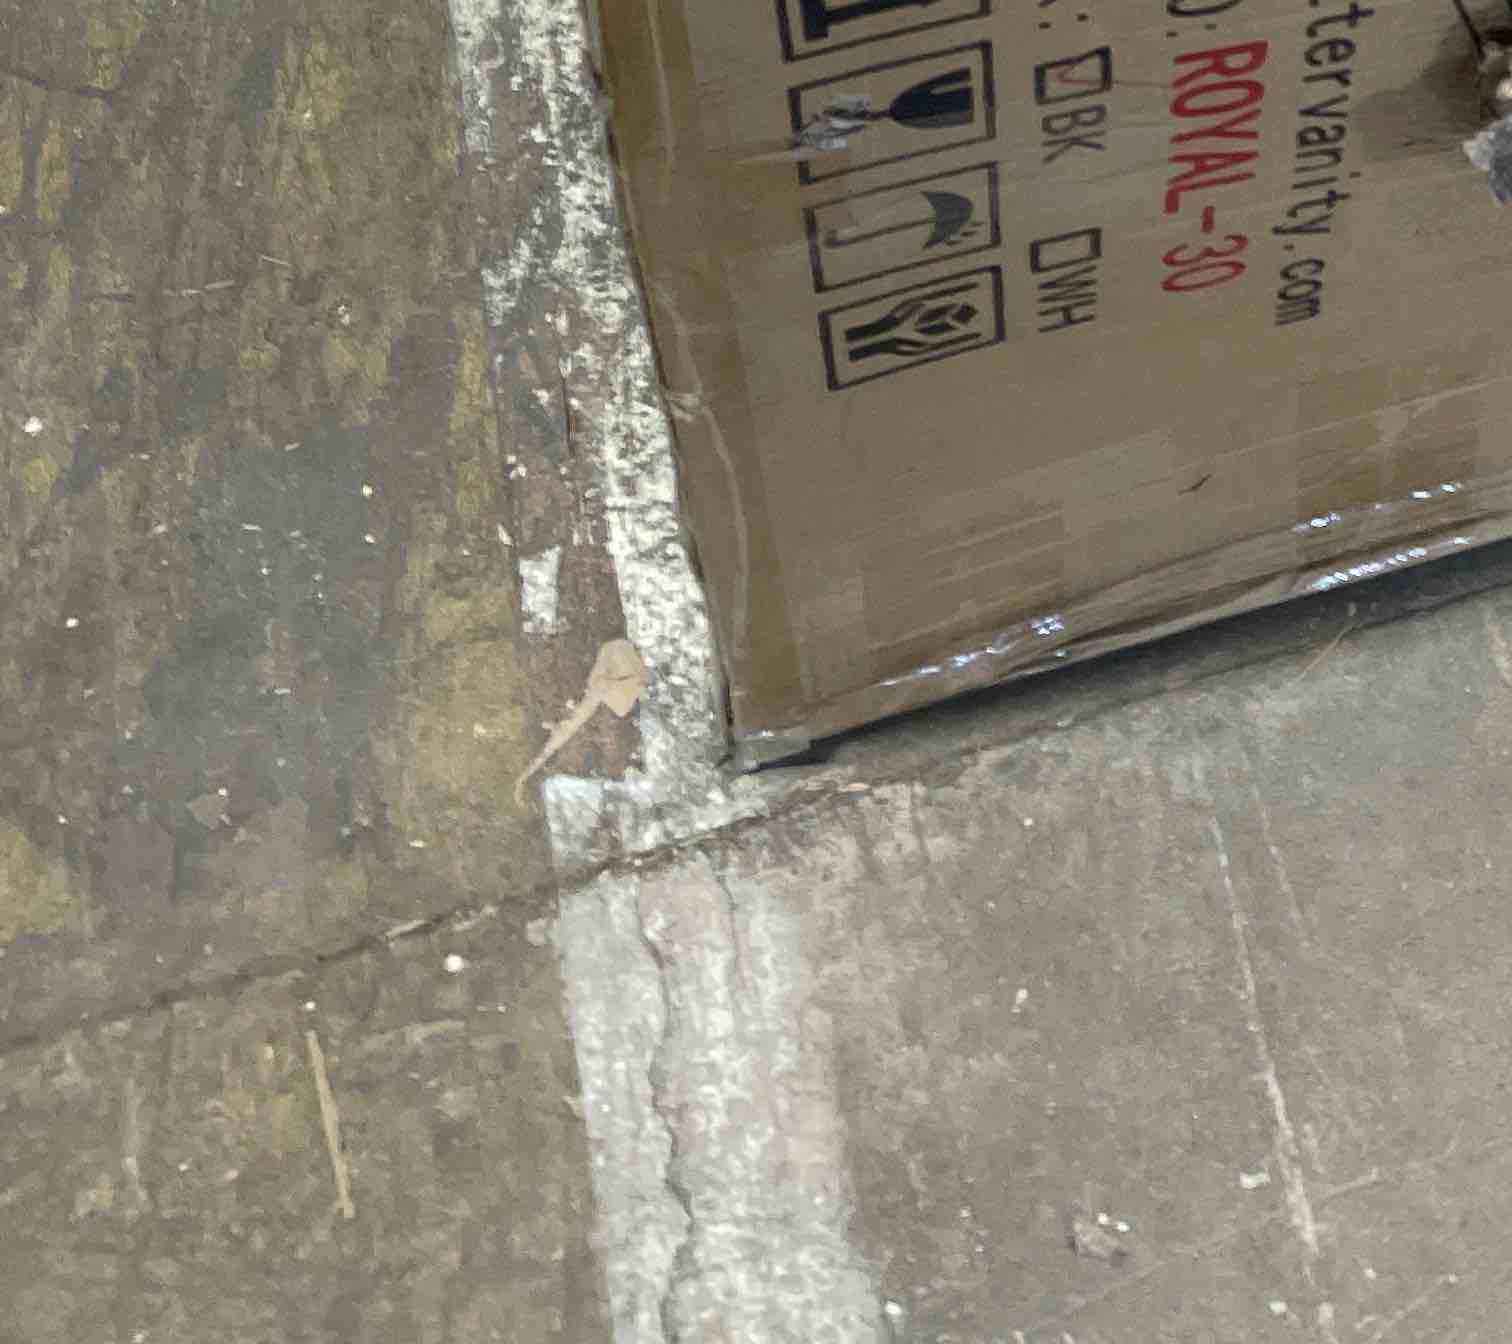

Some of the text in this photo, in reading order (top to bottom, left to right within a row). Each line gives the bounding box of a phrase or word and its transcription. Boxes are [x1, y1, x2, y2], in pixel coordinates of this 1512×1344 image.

[1041, 104, 1108, 166] BK
[1161, 40, 1269, 294] ROYAL-30
[1037, 264, 1098, 335] WH
